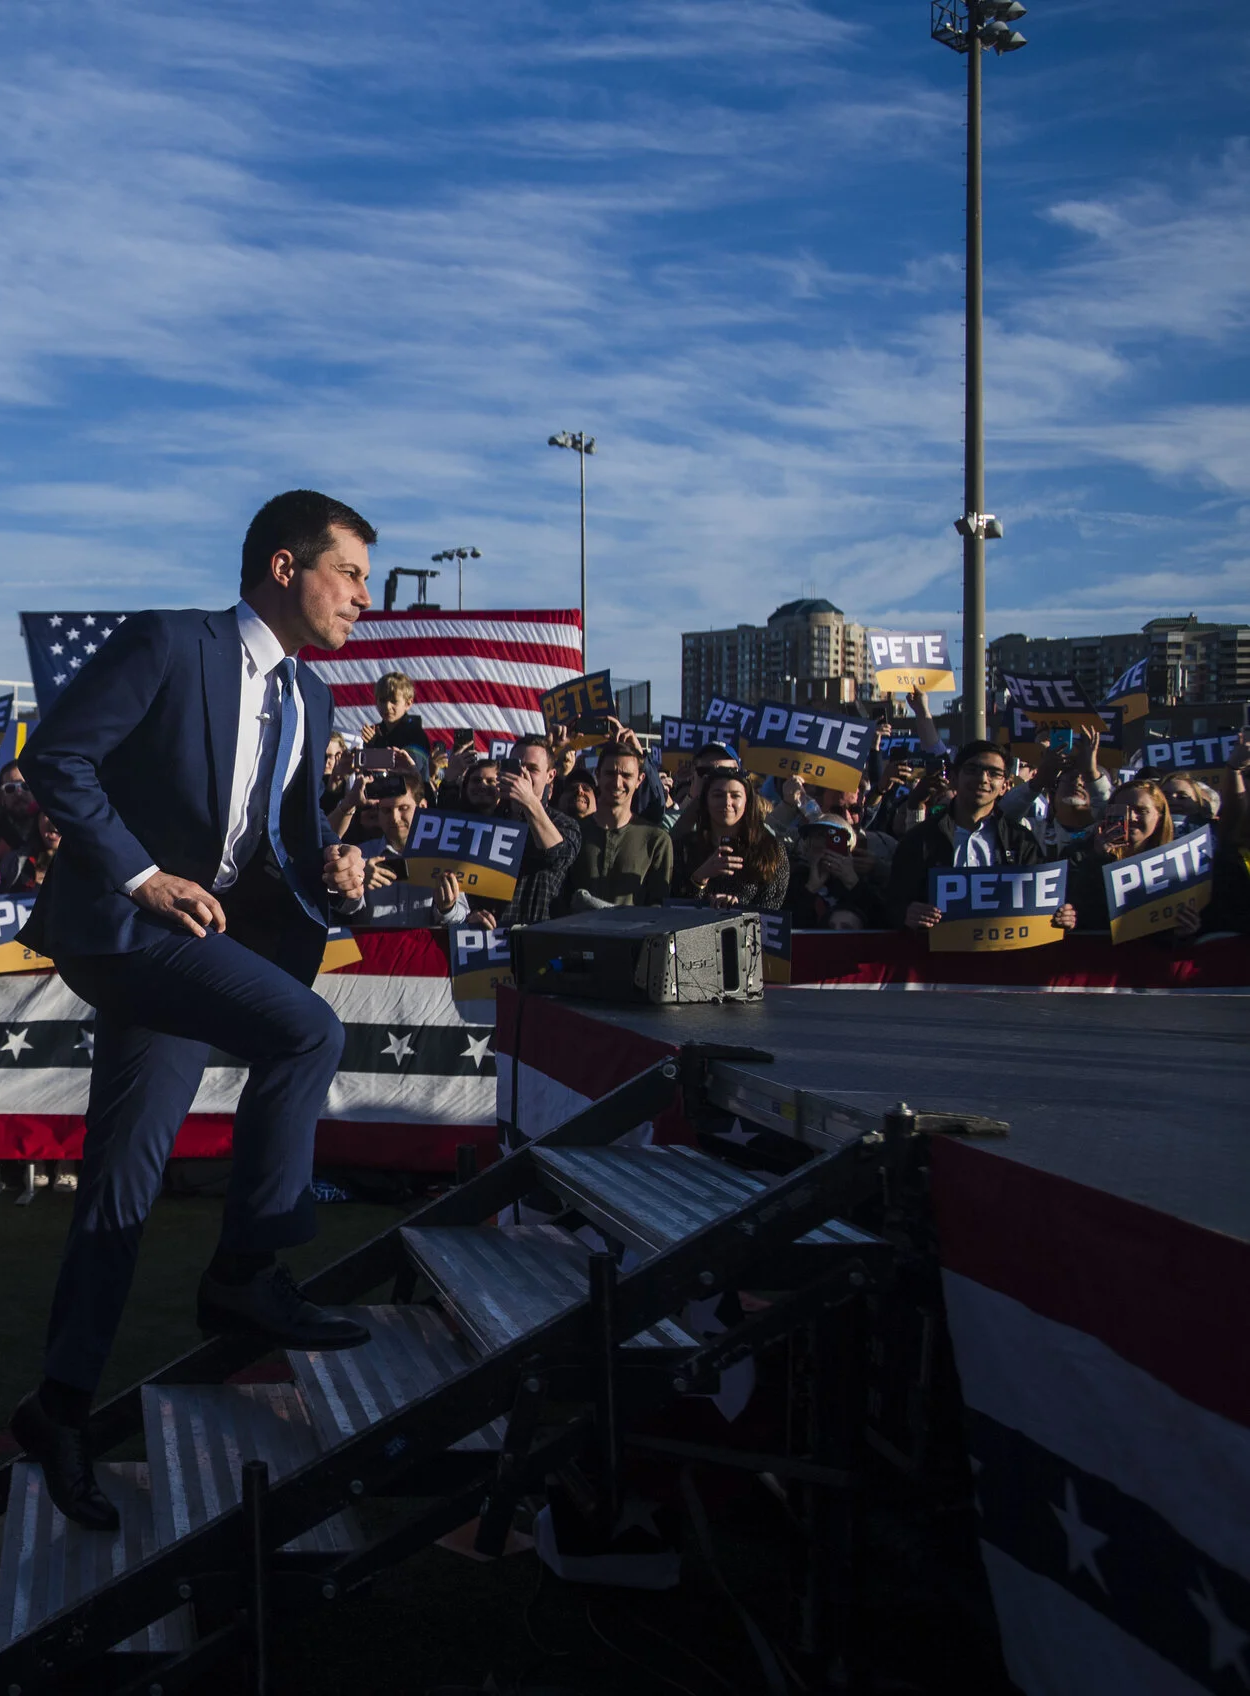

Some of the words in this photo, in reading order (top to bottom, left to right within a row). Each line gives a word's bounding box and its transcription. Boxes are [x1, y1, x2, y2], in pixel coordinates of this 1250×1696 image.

[870, 635, 945, 666] PETE
[543, 676, 610, 732] PETE
[1003, 674, 1086, 708] PETE
[663, 719, 736, 749] PETE
[756, 706, 869, 760] PETE
[778, 757, 826, 778] 2020
[411, 814, 520, 867] PETE
[431, 867, 479, 886] 220
[1111, 833, 1210, 908] PETE
[936, 868, 1062, 913] PETE
[973, 926, 1029, 941] 2020
